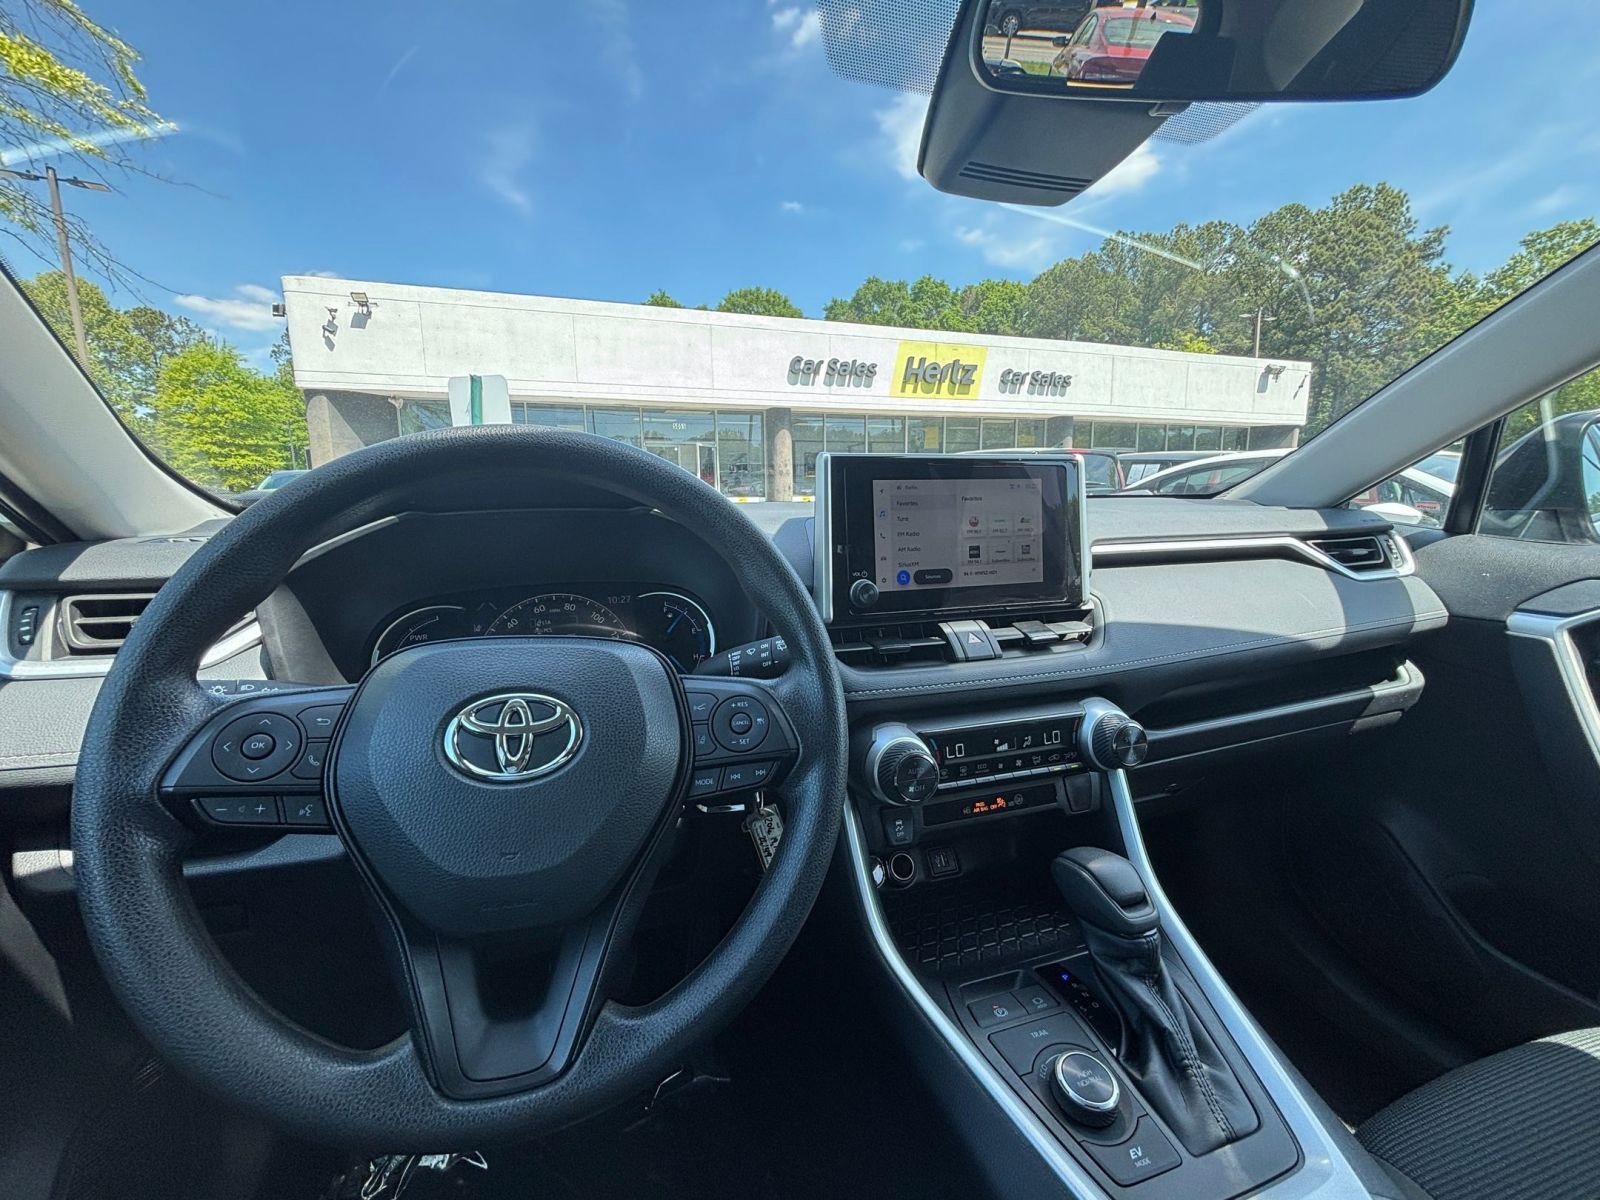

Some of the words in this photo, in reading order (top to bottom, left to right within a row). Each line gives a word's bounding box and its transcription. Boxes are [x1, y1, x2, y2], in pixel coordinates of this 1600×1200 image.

[789, 355, 824, 375] Car
[826, 357, 877, 378] Sales
[905, 356, 978, 385] Hertz
[1000, 368, 1029, 385] Car
[1030, 370, 1072, 388] Sales
[533, 604, 547, 614] 60
[563, 602, 577, 612] 80
[506, 618, 519, 630] 40
[590, 610, 605, 625] 100
[409, 633, 429, 641] PWR
[1043, 730, 1061, 745] LO
[251, 741, 266, 749] OK
[946, 743, 965, 759] LO
[695, 777, 714, 785] MODE
[1129, 1146, 1143, 1160] EV
